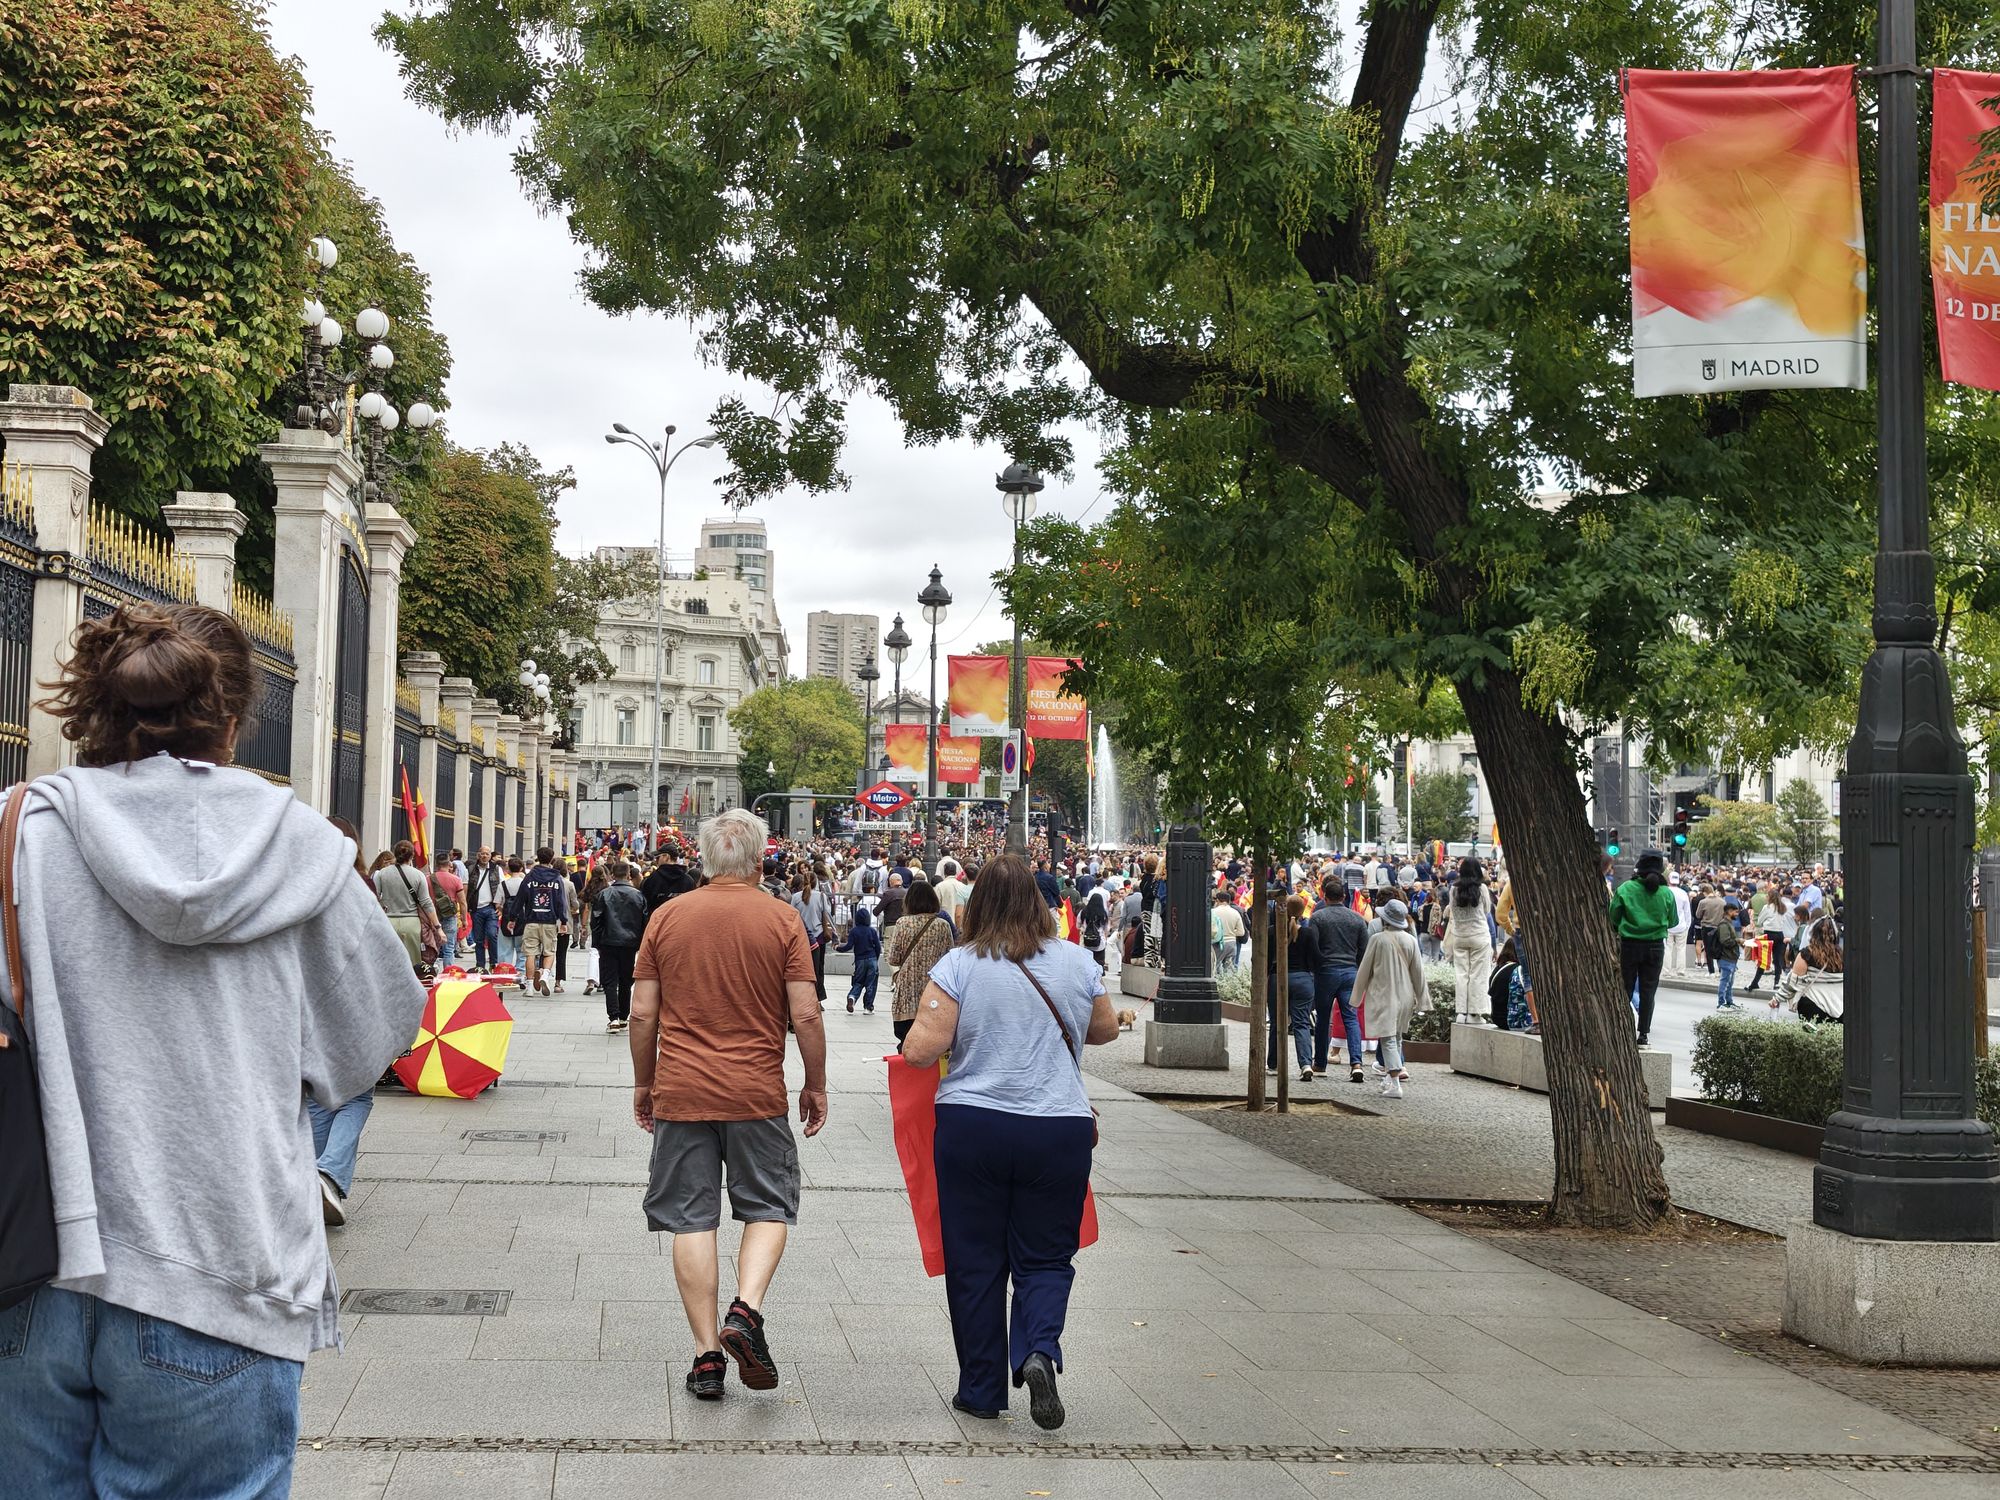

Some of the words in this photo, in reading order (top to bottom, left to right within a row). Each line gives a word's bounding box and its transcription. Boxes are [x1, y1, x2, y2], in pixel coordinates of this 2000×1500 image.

[1945, 297, 1965, 318] 12
[1731, 358, 1819, 377] MADRID
[1030, 690, 1058, 699] FIEST
[1030, 701, 1084, 711] NACIONAL
[941, 747, 963, 755] FIESTA
[941, 755, 978, 764] NACIONAL
[872, 793, 898, 803] Metro
[887, 822, 909, 830] España
